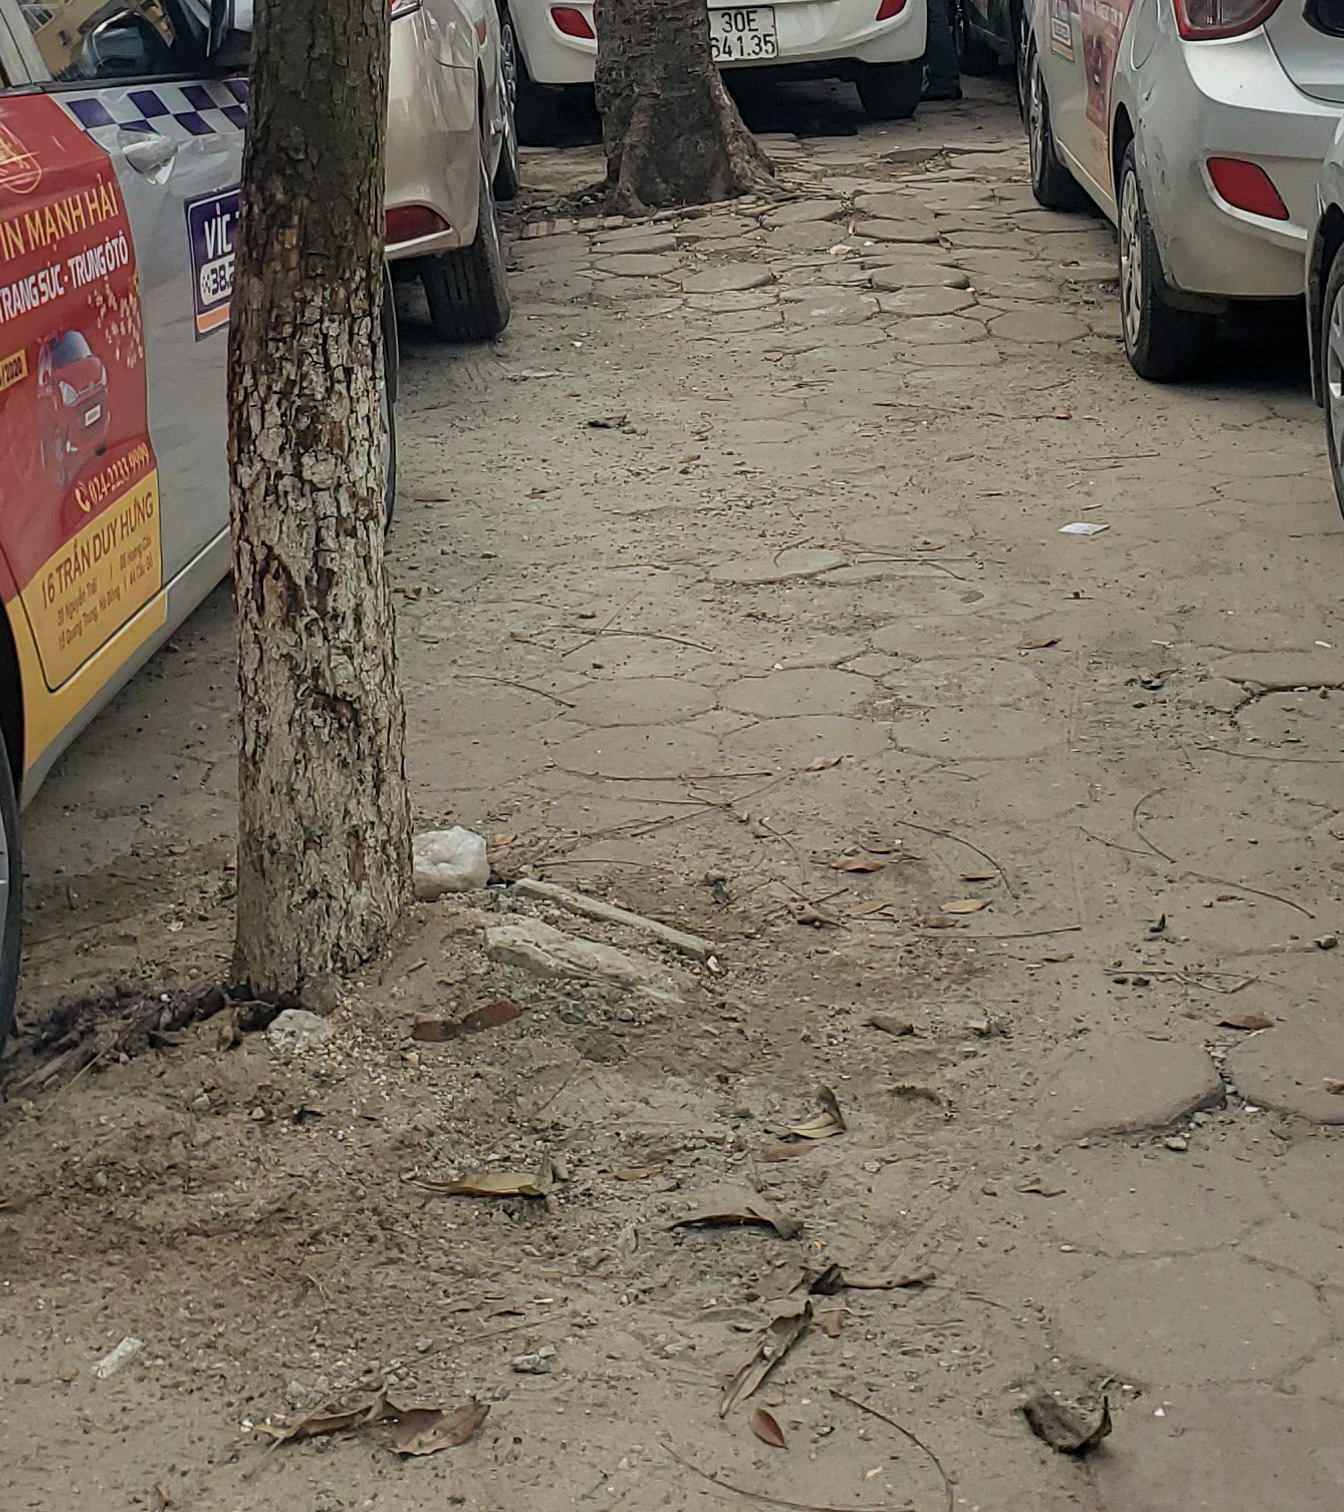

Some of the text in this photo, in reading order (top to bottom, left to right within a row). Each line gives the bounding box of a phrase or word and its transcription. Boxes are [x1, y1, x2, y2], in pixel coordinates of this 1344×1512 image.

[721, 10, 759, 33] 30E
[710, 34, 775, 58] 641.35
[25, 193, 86, 251] MẠNH
[84, 172, 119, 225] HẢI
[67, 245, 105, 288] TRÚNG
[129, 442, 149, 471] 9999
[42, 491, 154, 610] 16 TRẦN DUY HƯNG
